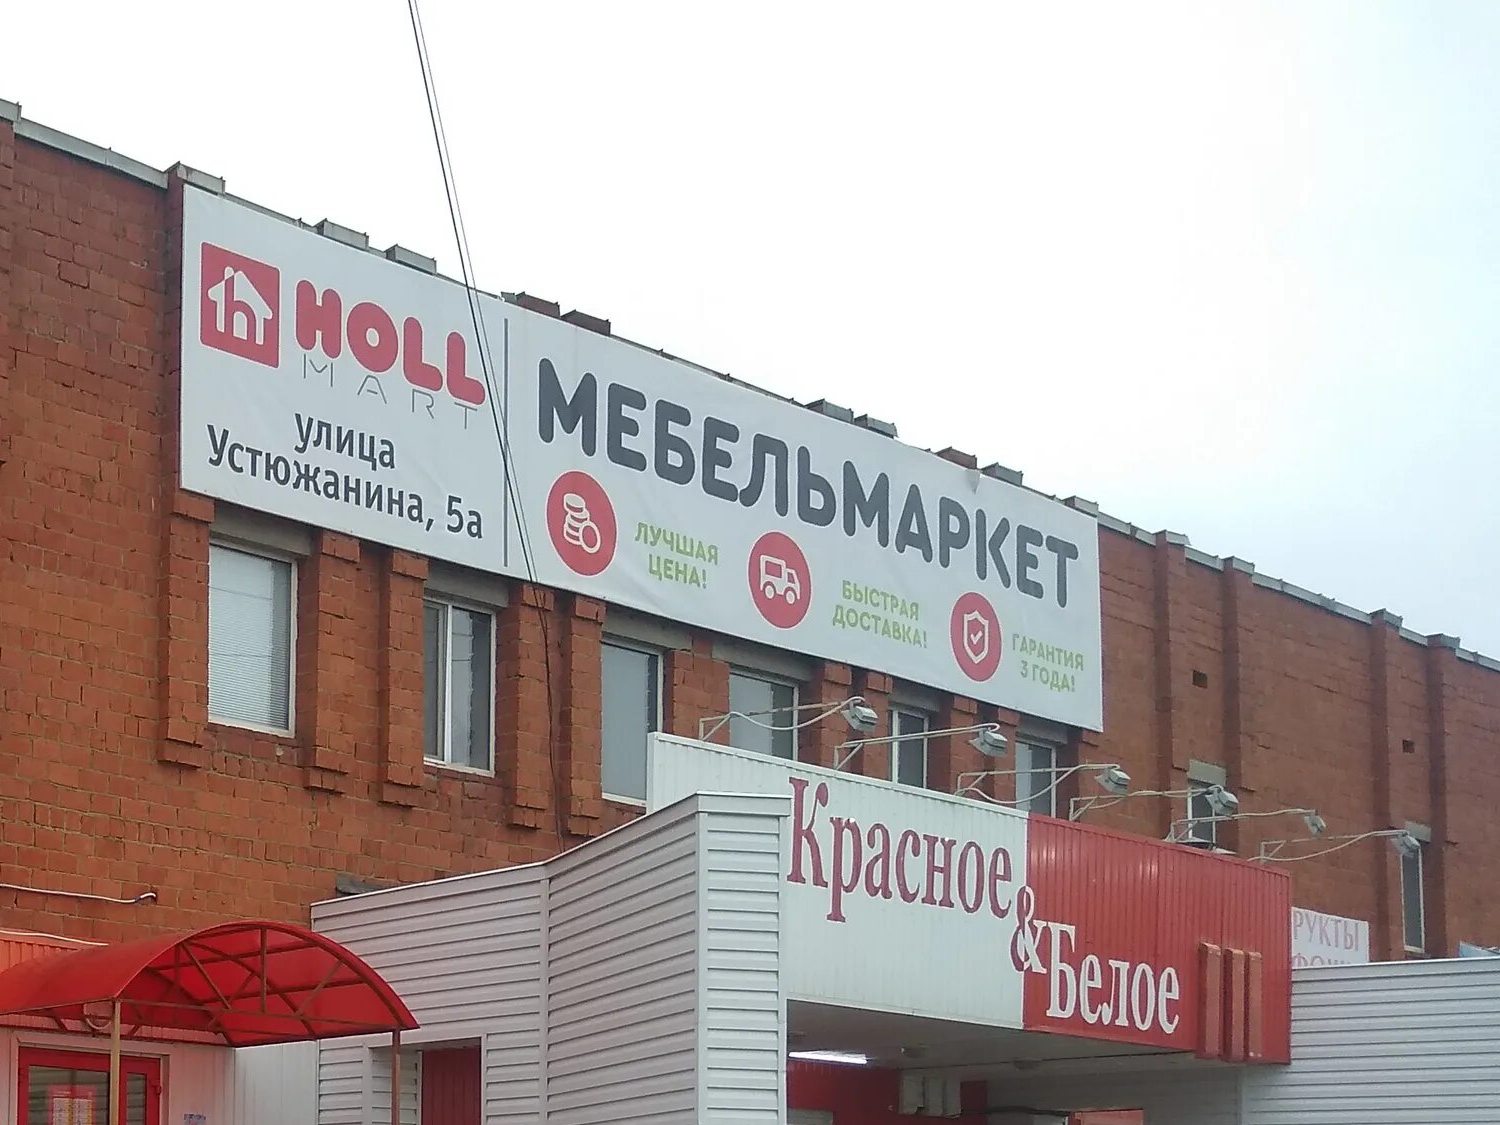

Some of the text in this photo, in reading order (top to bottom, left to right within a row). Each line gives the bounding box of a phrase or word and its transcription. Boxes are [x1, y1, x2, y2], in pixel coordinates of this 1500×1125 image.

[295, 280, 486, 405] HOLL
[303, 353, 478, 429] MART
[294, 413, 395, 472] улица
[207, 424, 483, 539] Устюжанина, 5а
[539, 358, 1079, 608] МЕБЕЛЬМАРКЕТ
[635, 522, 719, 565] ЛУЧШАЯ
[648, 554, 707, 589] ЦЕНА!
[842, 580, 919, 621] БЫСТРАЯ
[832, 605, 927, 648] ДОСТАВКА!
[1012, 634, 1084, 671] ГАРАНТИЯ
[1020, 661, 1075, 692] 3 ГОДА!
[787, 777, 1180, 1034] Красное & Белое
